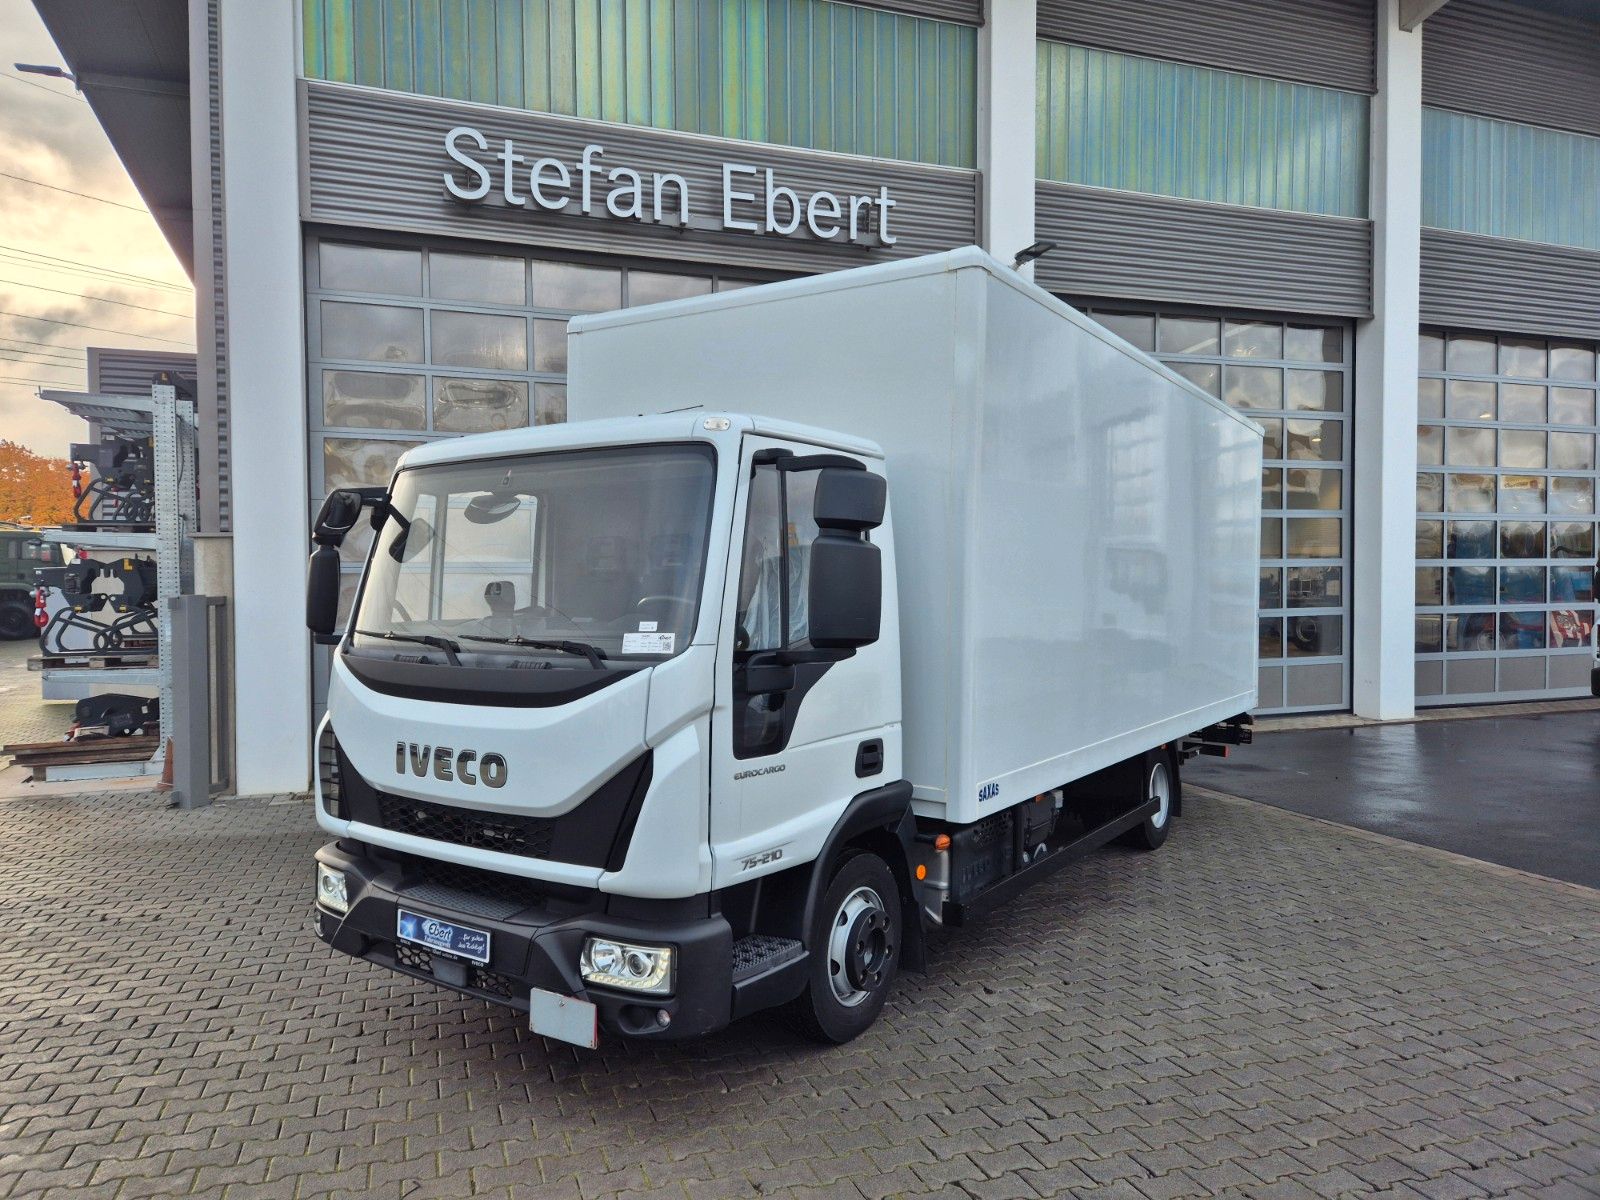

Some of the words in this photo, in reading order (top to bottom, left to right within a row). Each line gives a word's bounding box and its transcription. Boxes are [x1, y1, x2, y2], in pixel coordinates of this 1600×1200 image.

[443, 126, 689, 226] Stefan
[722, 162, 897, 248] Ebert
[396, 741, 508, 788] IVECO
[734, 764, 786, 781] EUROCARGO
[978, 783, 1000, 802] SAXAS
[741, 849, 783, 872] 75-210
[428, 922, 452, 939] Ebert
